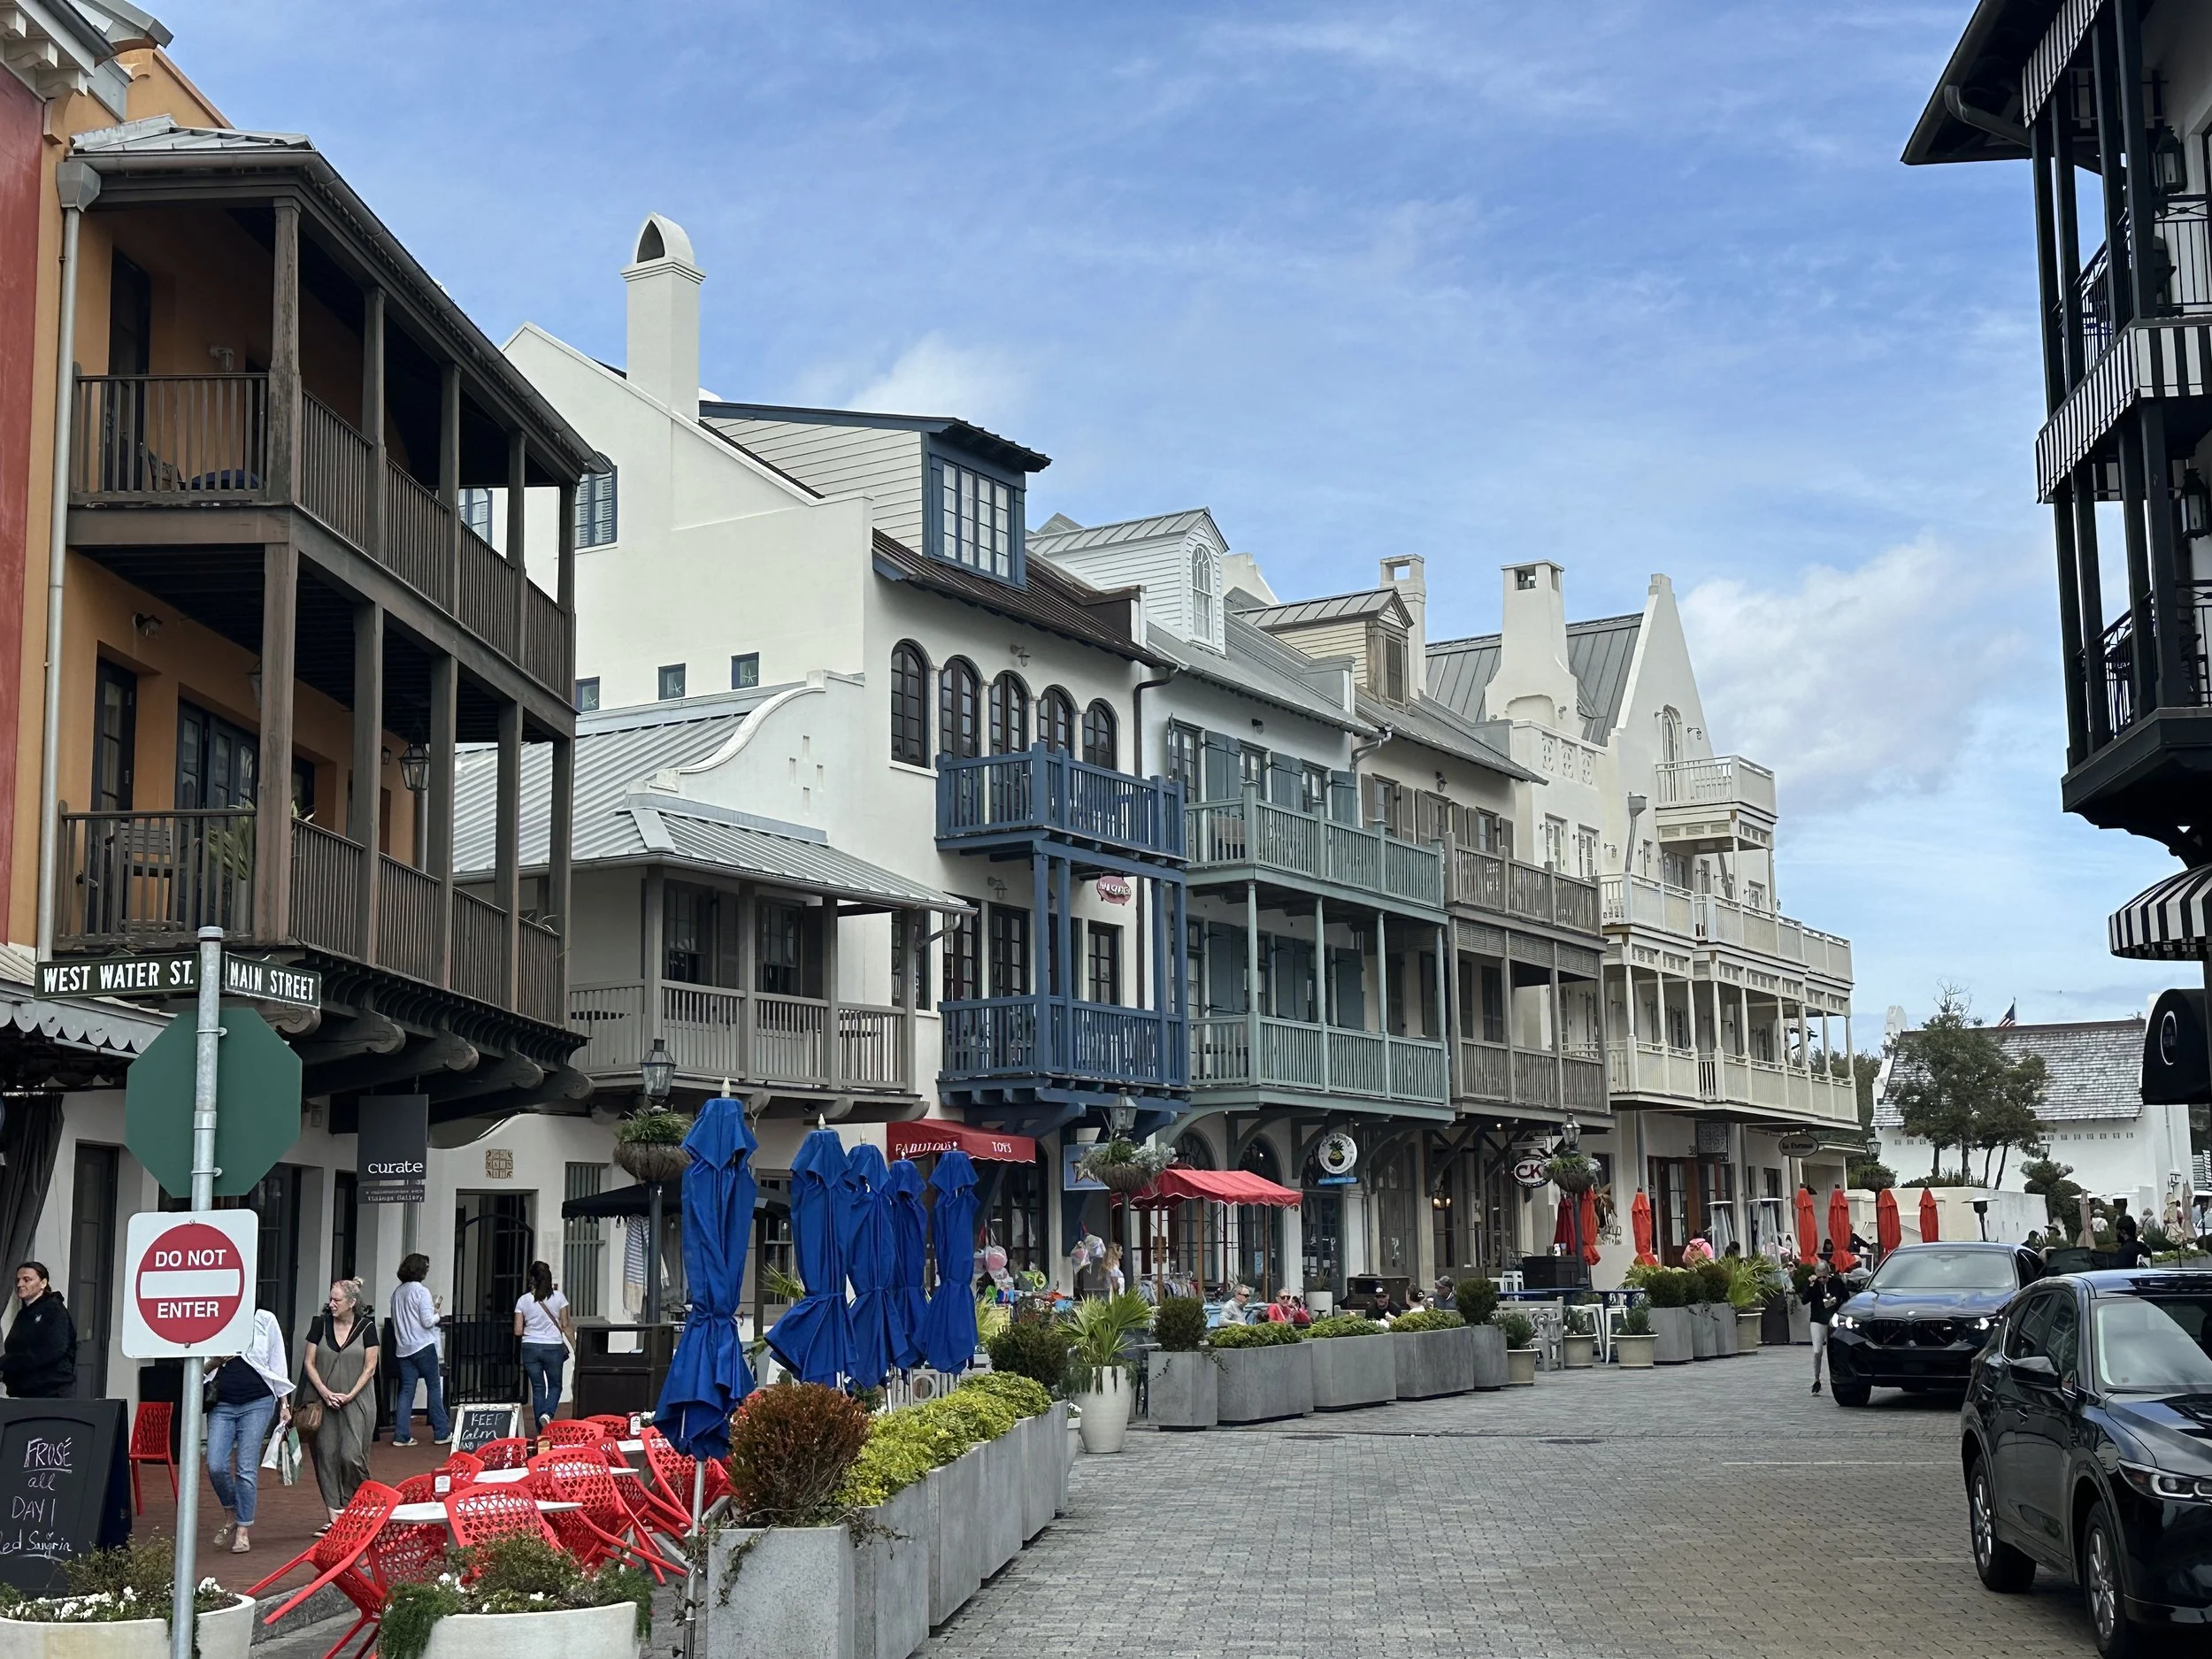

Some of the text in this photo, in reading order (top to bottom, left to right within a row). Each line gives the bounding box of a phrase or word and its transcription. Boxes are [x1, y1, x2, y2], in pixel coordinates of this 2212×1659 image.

[43, 960, 194, 993] WEST WATER ST.
[230, 961, 314, 1001] MAIN STREET
[992, 1141, 1012, 1153] TOYS
[367, 1160, 424, 1174] curate
[1515, 1164, 1542, 1179] CK
[155, 1248, 227, 1267] DO NOT
[157, 1301, 219, 1319] ENTER
[471, 1412, 504, 1426] KEEP
[24, 1437, 72, 1468] FROSÉ
[27, 1472, 55, 1491] all
